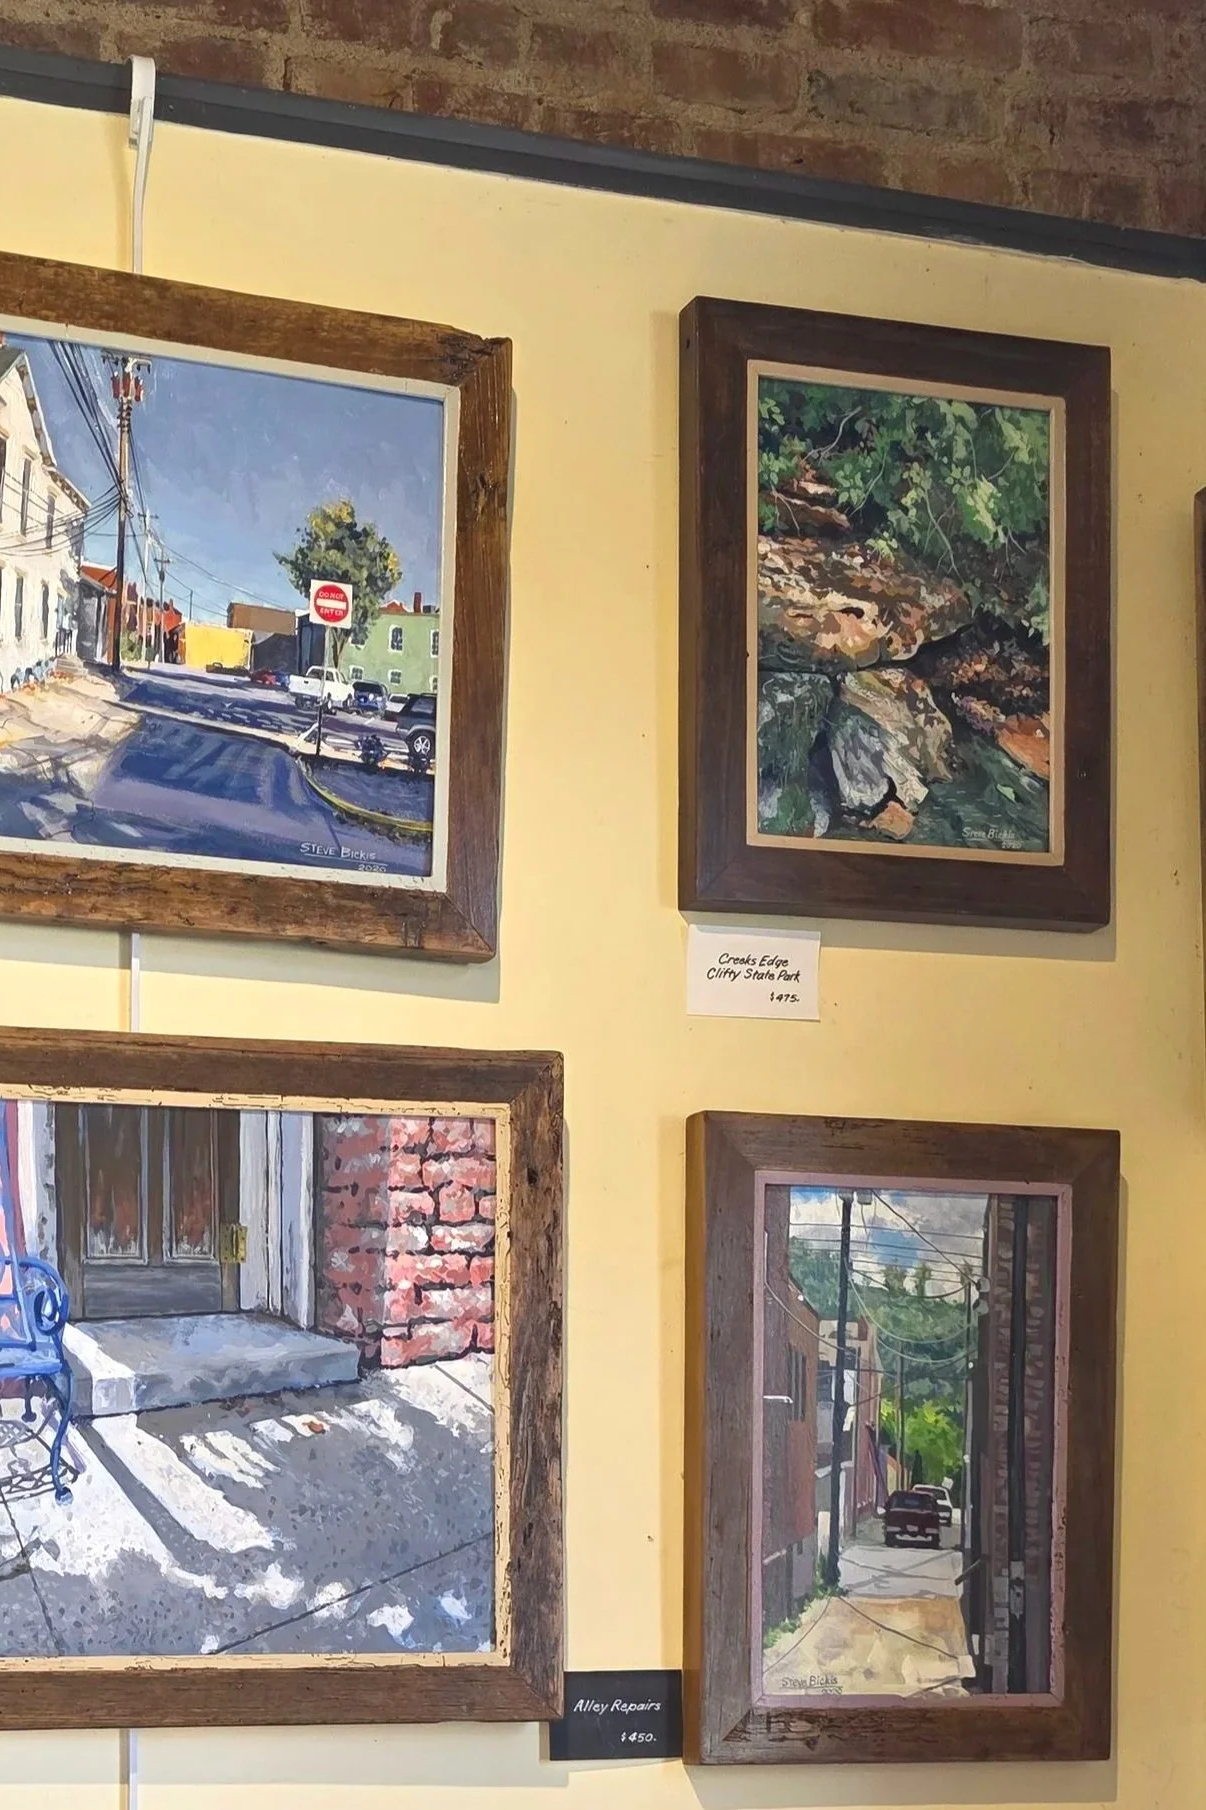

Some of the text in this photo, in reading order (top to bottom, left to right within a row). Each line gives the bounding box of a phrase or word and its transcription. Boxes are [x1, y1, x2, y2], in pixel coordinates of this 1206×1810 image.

[300, 842, 335, 856] STEVE
[718, 952, 790, 969] Creeks Edge
[706, 967, 801, 983] Clifty State Park
[573, 1698, 661, 1715] Alley Repairs
